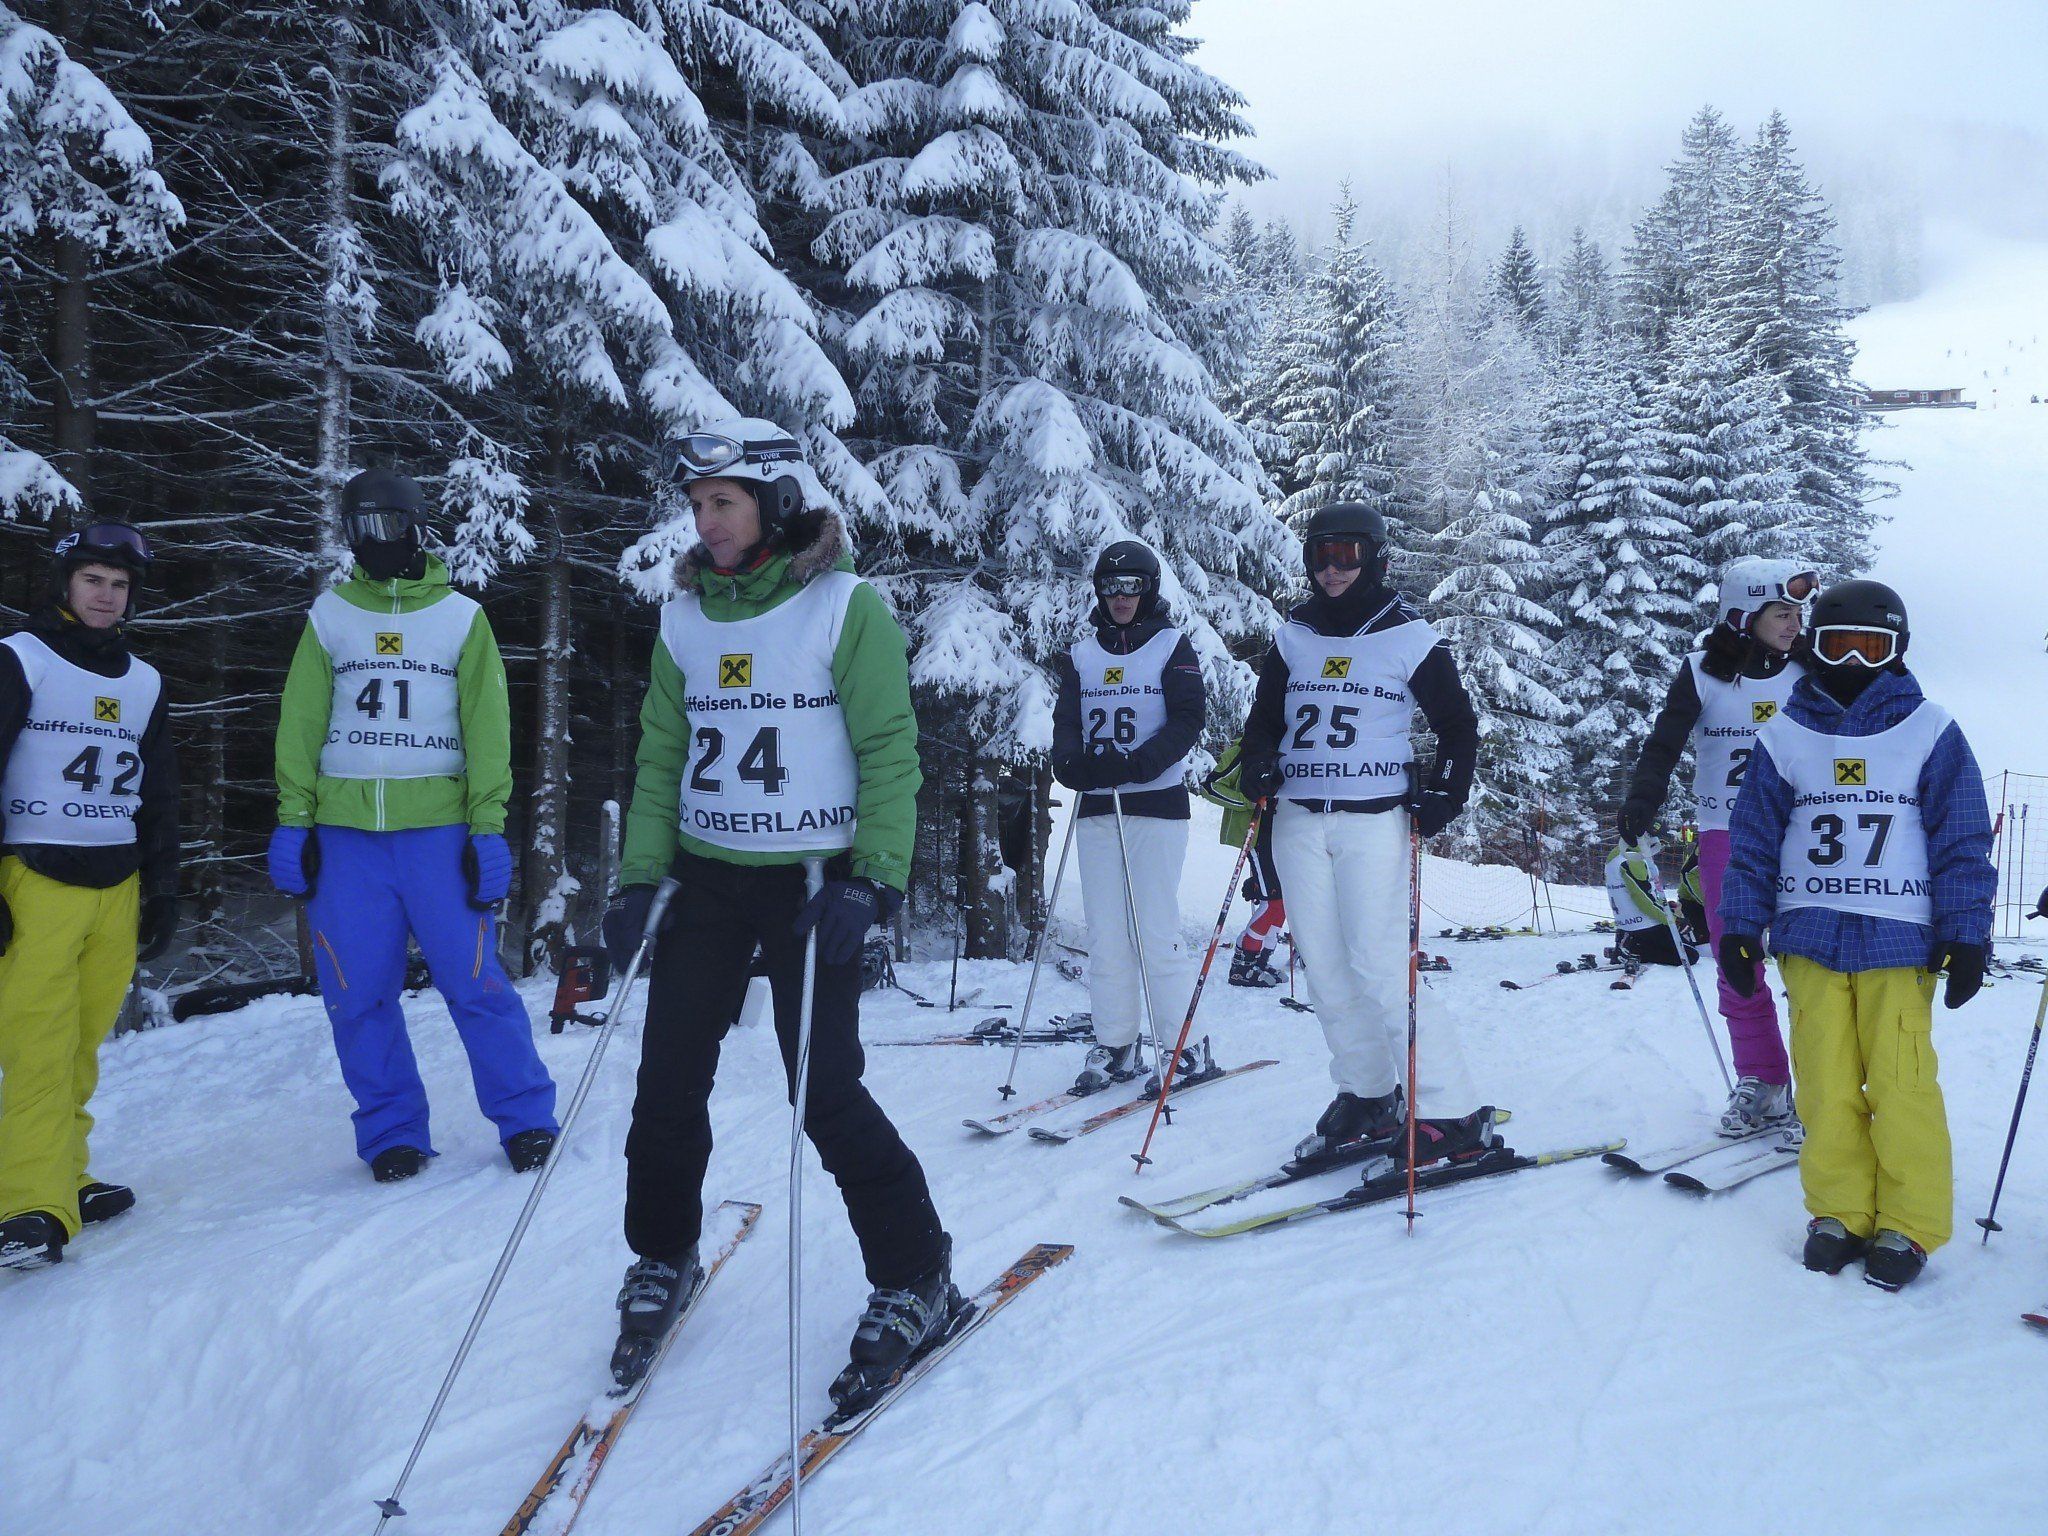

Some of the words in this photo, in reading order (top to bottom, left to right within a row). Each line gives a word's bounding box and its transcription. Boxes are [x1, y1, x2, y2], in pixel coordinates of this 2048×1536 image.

[760, 452, 781, 460] uvex
[356, 678, 412, 721] 41
[793, 690, 839, 709] Bank
[1144, 685, 1163, 695] Ban
[1373, 686, 1406, 703] Bank
[1088, 706, 1138, 746] 26
[1291, 704, 1362, 751] 25
[1703, 727, 1759, 737] Raiffeis
[348, 731, 460, 750] OBERLAND
[62, 745, 142, 796] 42
[690, 726, 790, 796] 24
[1284, 762, 1400, 778] OBERLAND
[1726, 748, 1753, 787] 2
[9, 799, 48, 816] SC
[62, 802, 137, 819] OBERL
[1700, 795, 1718, 810] SC
[694, 805, 855, 833] OBERLAND
[1807, 814, 1896, 868] 37
[1777, 876, 1796, 893] SC
[844, 887, 874, 903] FREE
